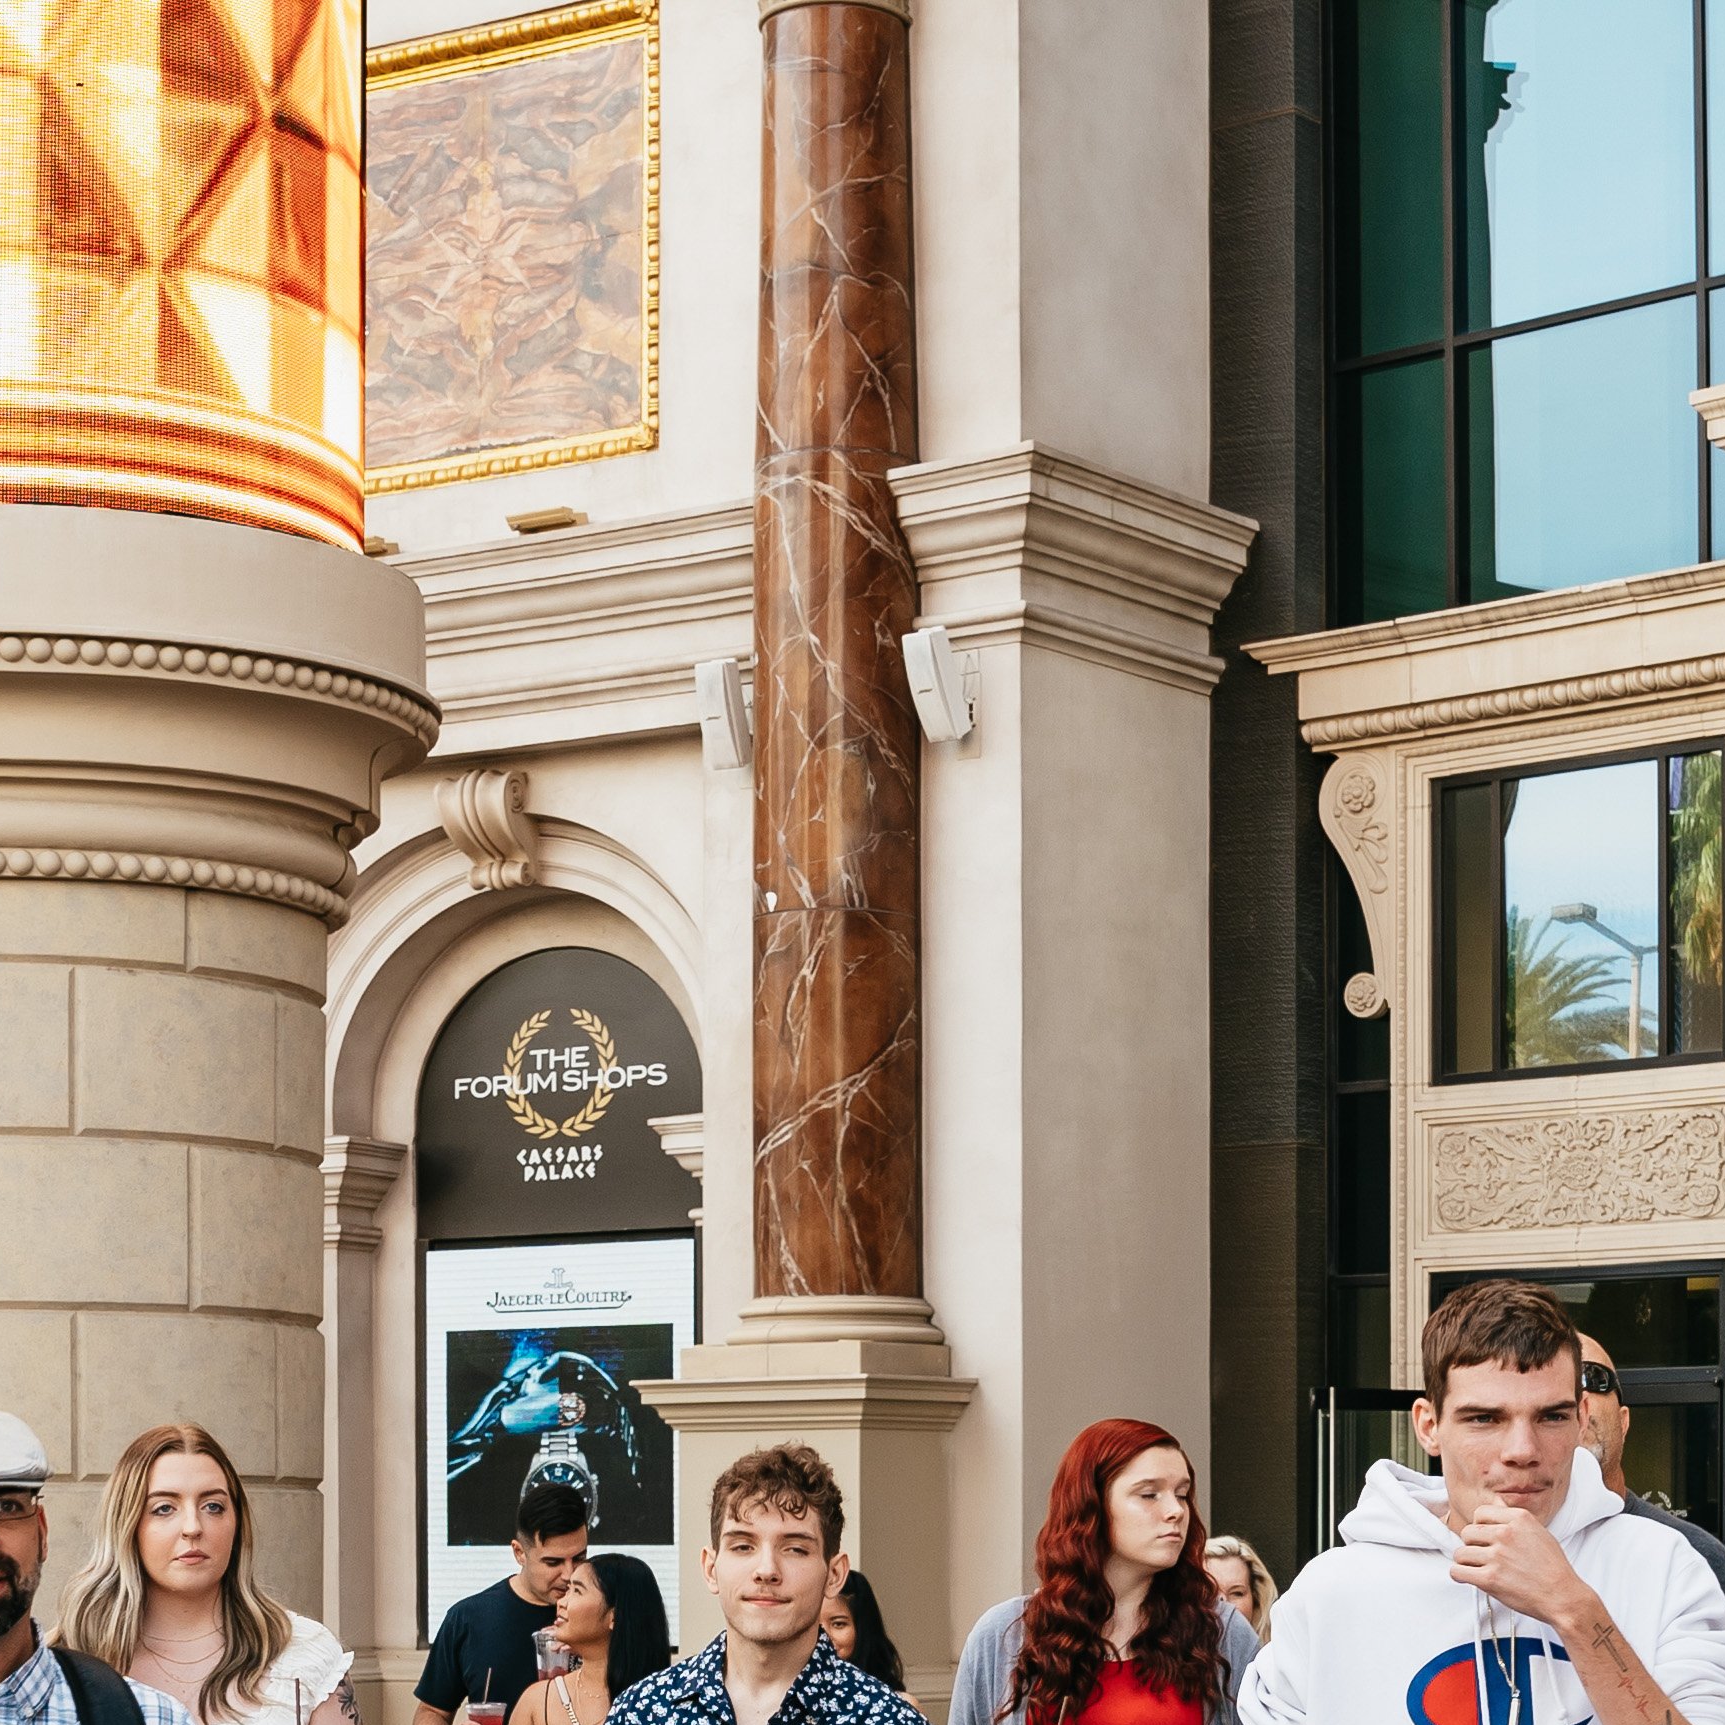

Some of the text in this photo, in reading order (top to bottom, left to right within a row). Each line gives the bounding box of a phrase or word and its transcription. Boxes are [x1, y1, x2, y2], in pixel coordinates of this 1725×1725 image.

[529, 1046, 590, 1070] THE
[454, 1063, 668, 1099] FORUM SHOPS
[516, 1144, 603, 1165] CAESARS
[524, 1162, 596, 1182] PALACE
